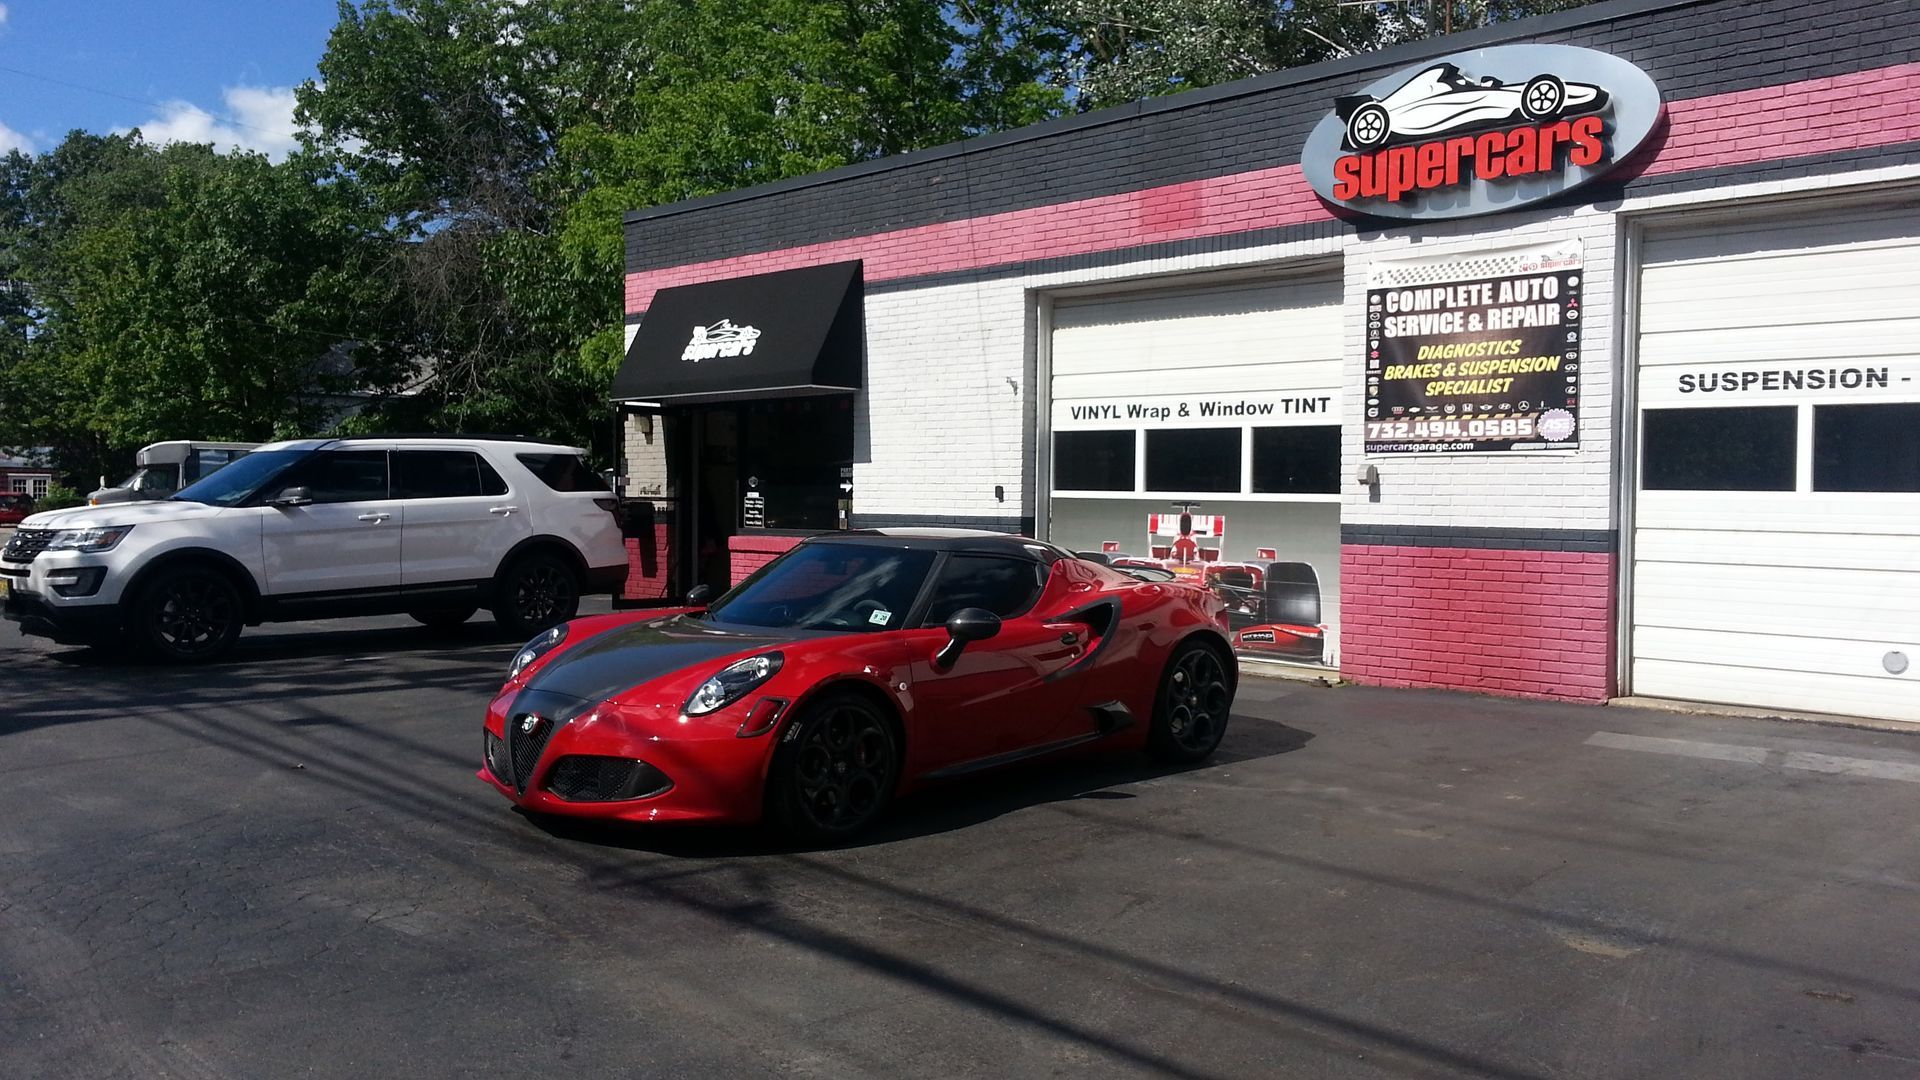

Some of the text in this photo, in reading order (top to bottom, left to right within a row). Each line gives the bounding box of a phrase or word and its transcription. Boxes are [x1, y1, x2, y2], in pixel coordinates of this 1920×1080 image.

[1333, 116, 1603, 201] supercars
[1386, 276, 1559, 313] COMPLETE AUTO
[1384, 303, 1560, 338] SERVICE & REPAIR
[1417, 339, 1522, 360] DIAGNOSTICS
[1384, 356, 1561, 381] BRAKES & SUSPENSION
[1678, 367, 1889, 394] SUSPENSION
[1425, 378, 1514, 397] SPECIALIST
[1071, 397, 1331, 421] VINYL Wrap & Window TINT
[1367, 420, 1532, 438] 732.494.0585
[1365, 442, 1474, 453] supercarsgarage.com
